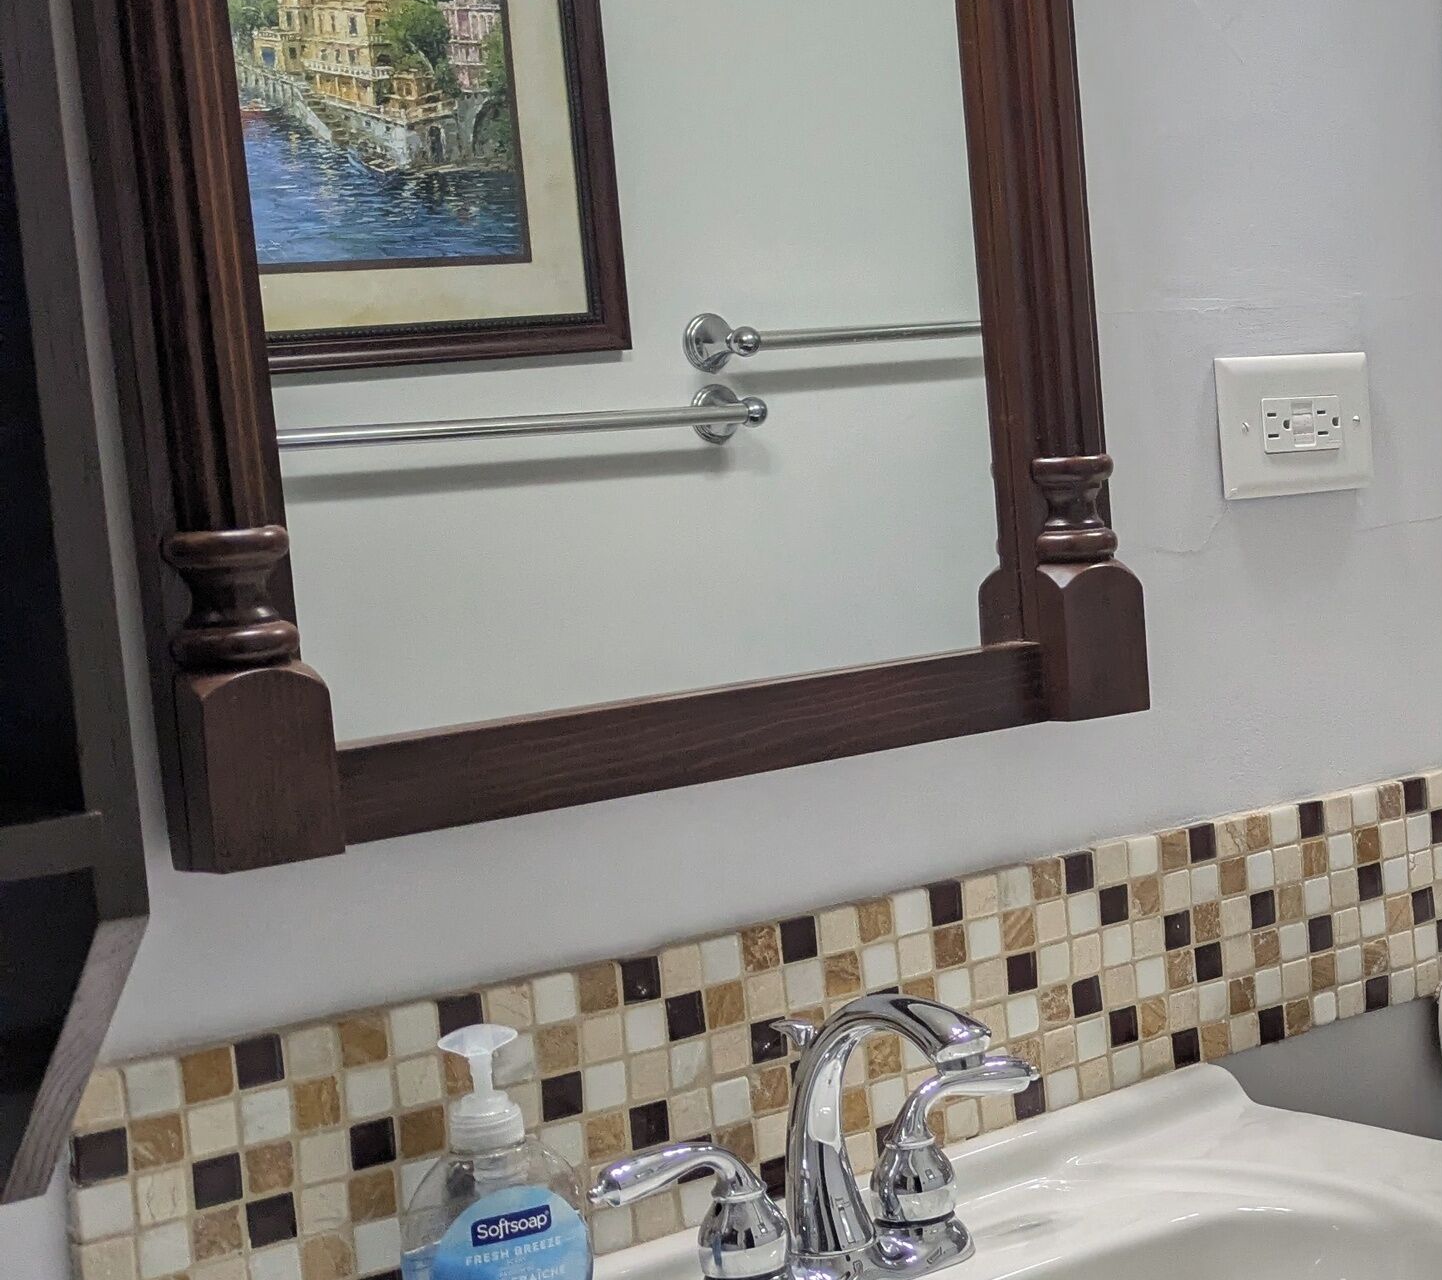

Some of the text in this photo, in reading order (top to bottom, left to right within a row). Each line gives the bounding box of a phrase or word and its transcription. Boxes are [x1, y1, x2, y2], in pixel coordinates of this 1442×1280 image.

[477, 1213, 547, 1239] Softsoap
[466, 1249, 509, 1266] FRESH
[514, 1236, 561, 1255] BREEZE
